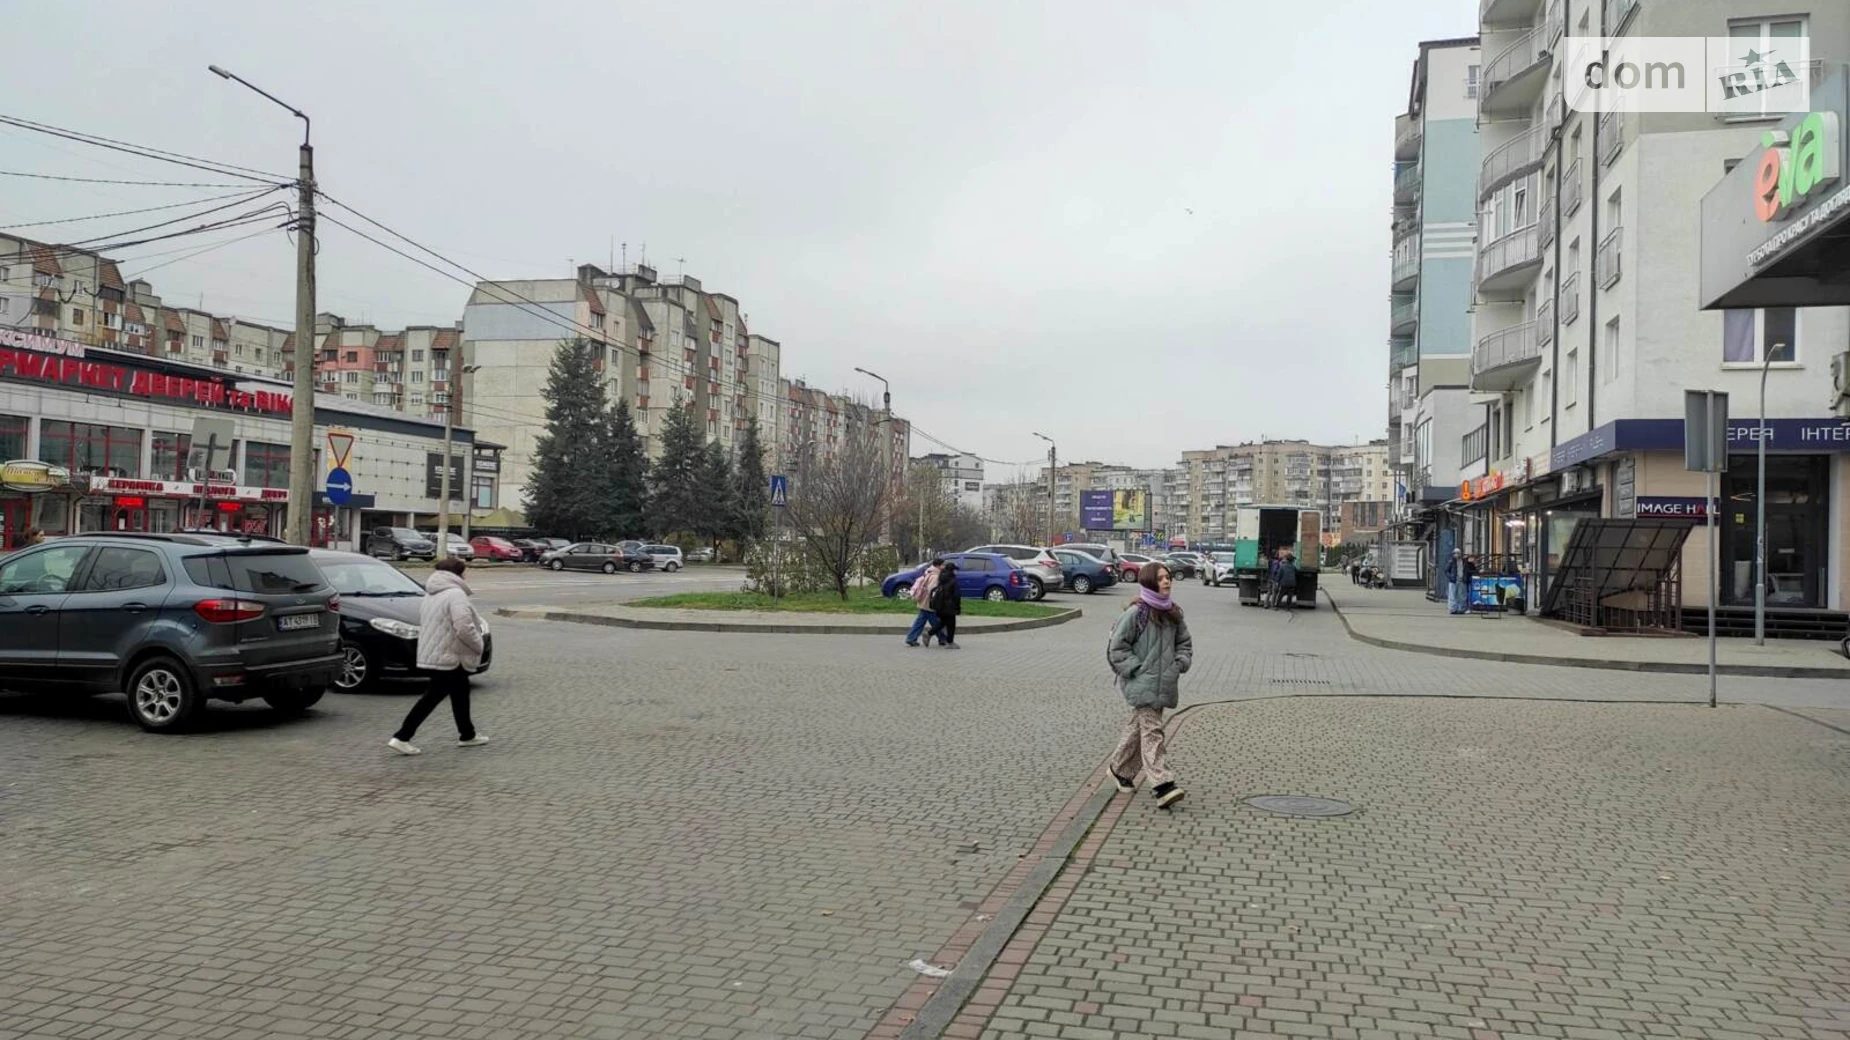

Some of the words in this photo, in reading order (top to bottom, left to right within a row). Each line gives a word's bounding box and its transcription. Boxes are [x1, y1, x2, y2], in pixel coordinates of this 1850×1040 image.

[1754, 111, 1834, 222] eva
[129, 369, 225, 404] ДВЕРЕЙ
[1637, 503, 1682, 514] IMAGE
